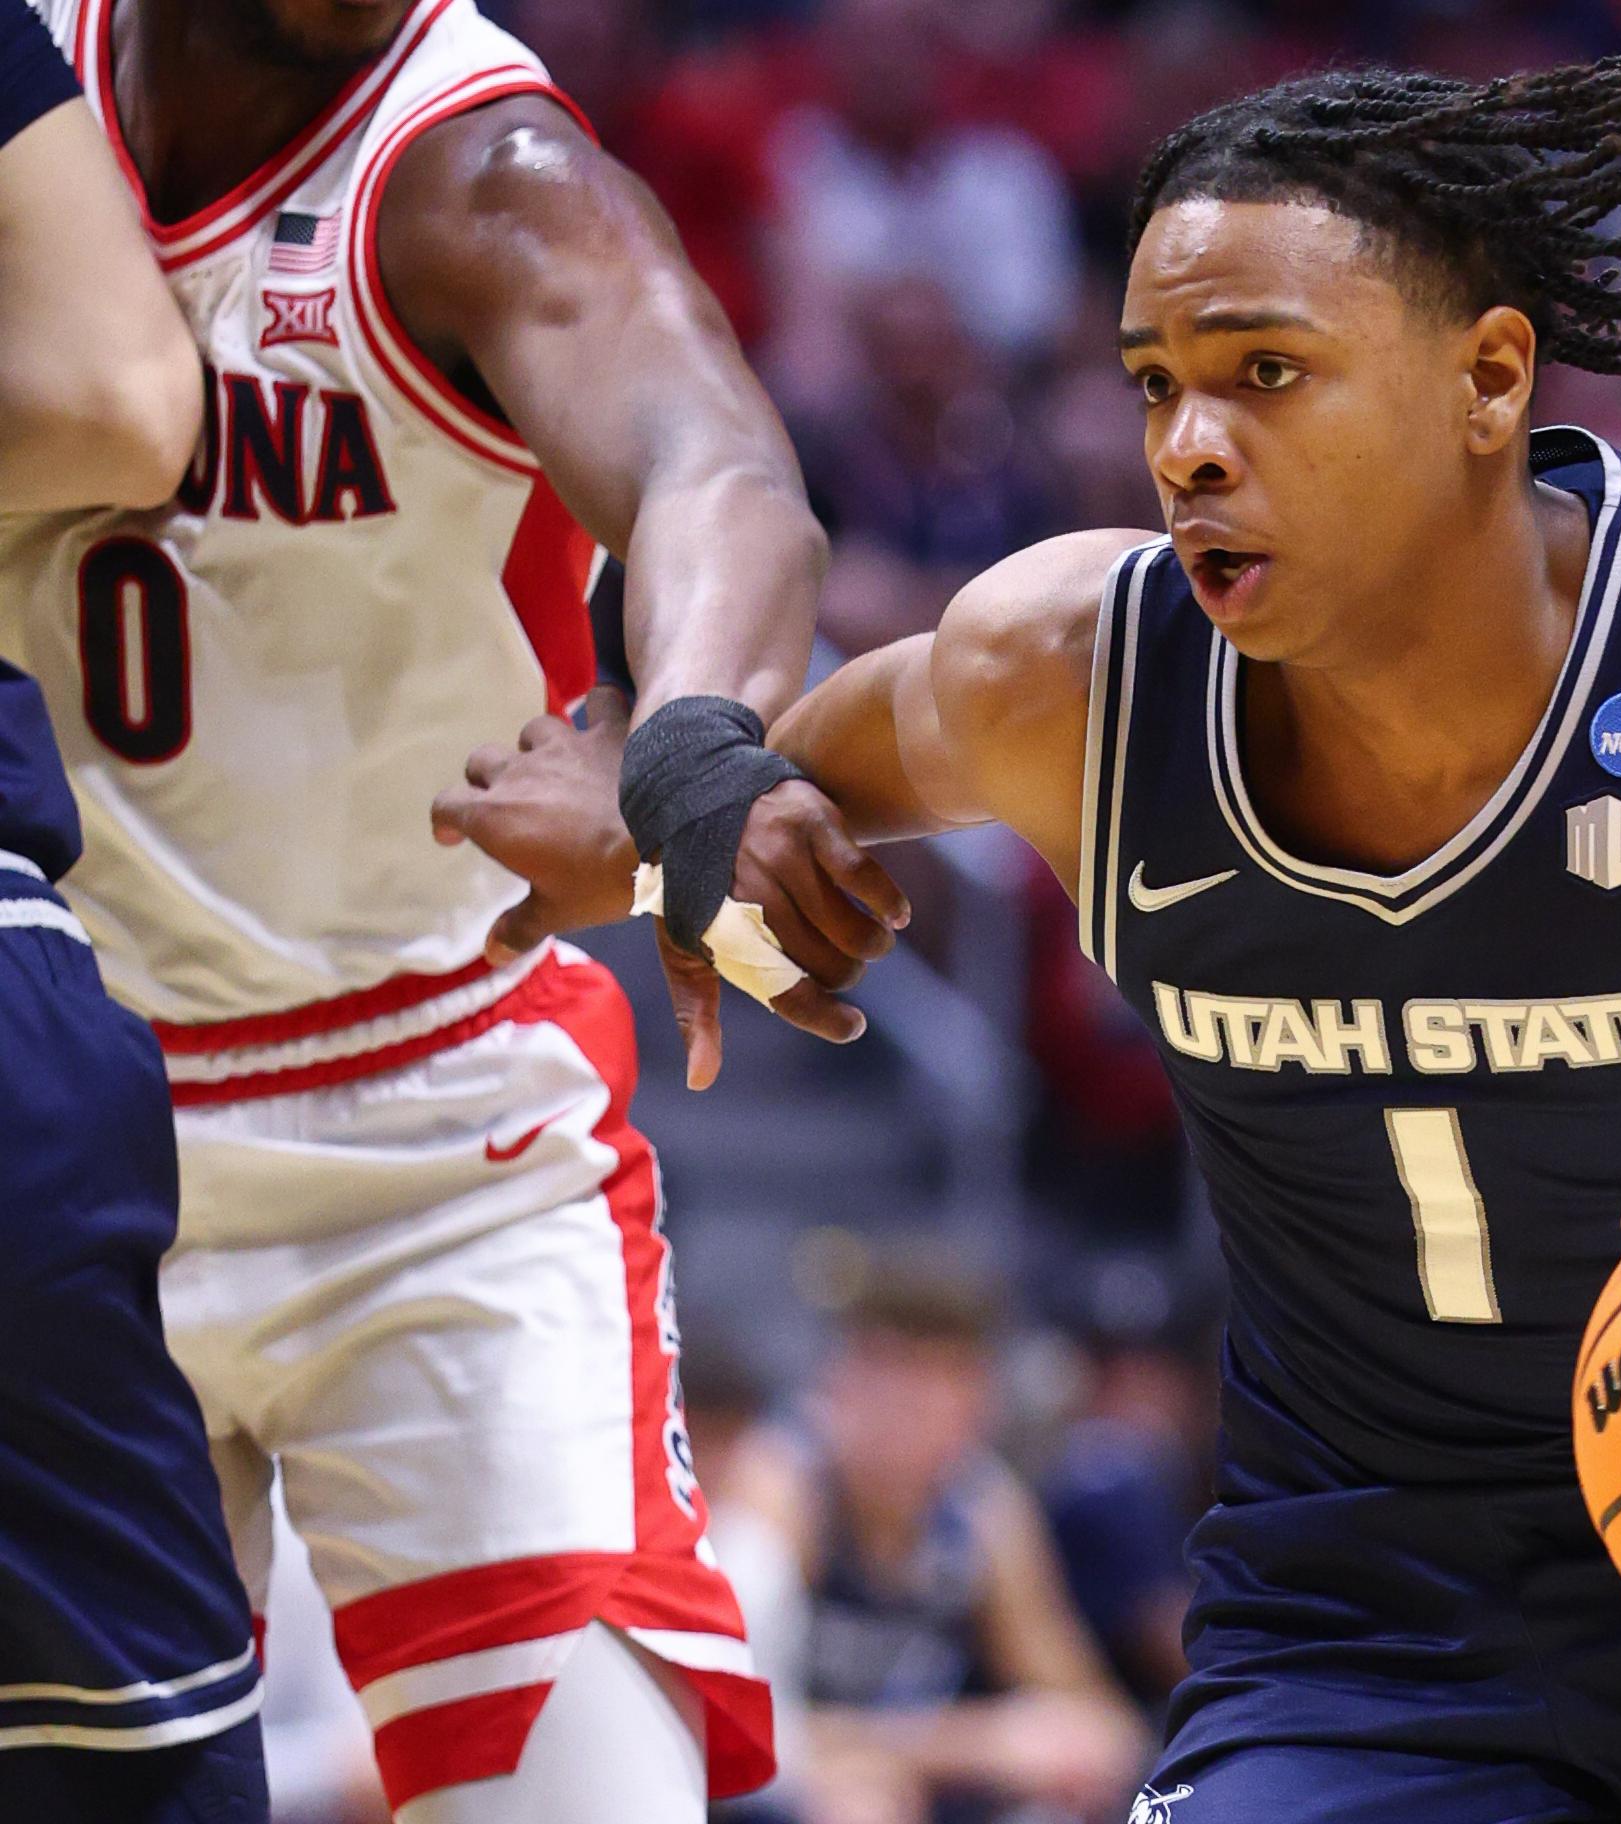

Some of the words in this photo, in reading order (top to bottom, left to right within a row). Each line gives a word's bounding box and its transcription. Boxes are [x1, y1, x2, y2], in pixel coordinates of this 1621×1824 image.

[78, 536, 192, 766] 0
[1152, 980, 1392, 1075] UTAH
[1384, 1107, 1502, 1324] 1
